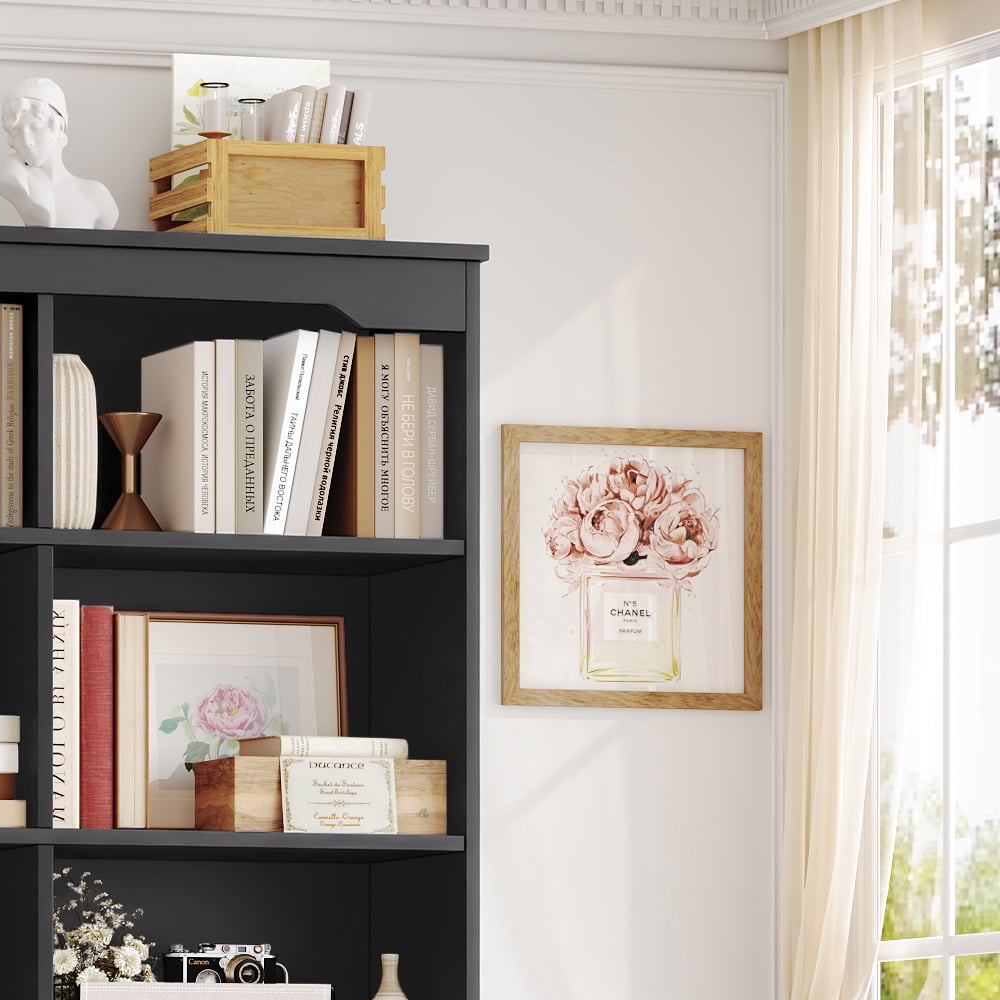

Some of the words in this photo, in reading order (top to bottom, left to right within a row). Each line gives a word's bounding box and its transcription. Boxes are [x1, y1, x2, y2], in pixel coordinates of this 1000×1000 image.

[201, 371, 209, 399] ИСТОРИЯ
[245, 374, 255, 419] ЗАБОТА
[381, 374, 389, 401] МОГУ
[6, 403, 18, 427] Religion
[402, 394, 415, 411] НЕ
[426, 386, 437, 418] ДАВИД
[5, 430, 14, 446] Greek
[245, 424, 255, 433] О
[329, 404, 342, 440] Религия
[381, 405, 389, 466] ОБЪЯСНИТЬ
[402, 414, 415, 447] БЕРИ
[5, 456, 16, 470] study
[201, 454, 209, 483] ИСТОРИЯ
[280, 439, 293, 483] ДАЛЬНЕГО
[323, 441, 334, 475] черной
[402, 450, 415, 462] В
[5, 471, 14, 482] the
[244, 436, 255, 513] ПРЕДАННЫХ
[381, 469, 389, 512] МНОГОЕ
[401, 463, 415, 513] ГОЛОВУ
[201, 483, 209, 516] ЧЕЛОВЕКА
[273, 484, 286, 521] ВОСТОКА
[314, 475, 327, 521] водолазки
[610, 608, 651, 617] CHANEL
[188, 958, 210, 966] Canon
